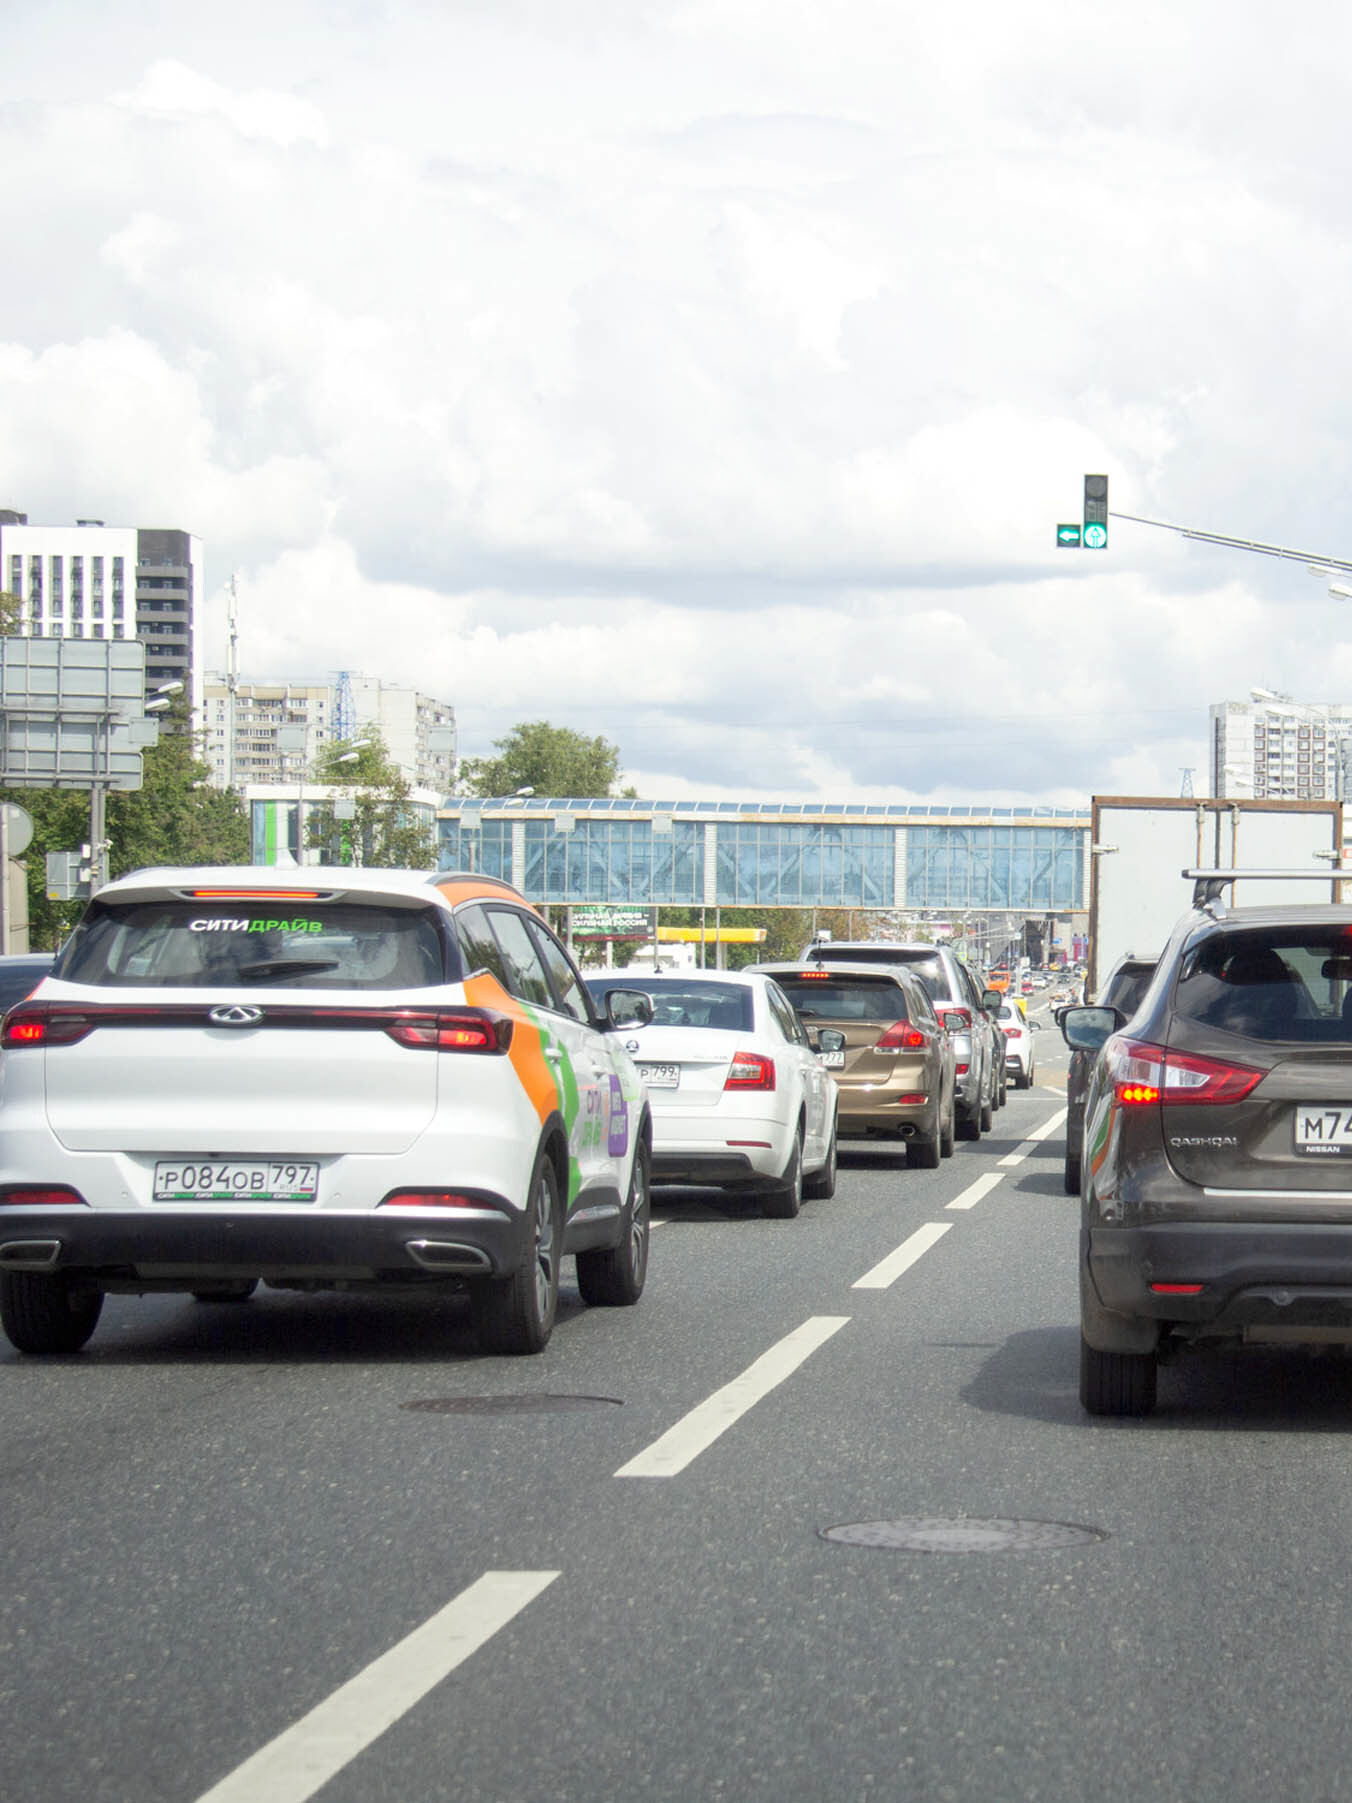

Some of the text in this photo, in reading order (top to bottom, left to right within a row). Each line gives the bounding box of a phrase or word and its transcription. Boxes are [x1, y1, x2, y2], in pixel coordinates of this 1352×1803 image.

[653, 1066, 675, 1077] 799
[164, 1165, 311, 1190] Р084ОВ 797
